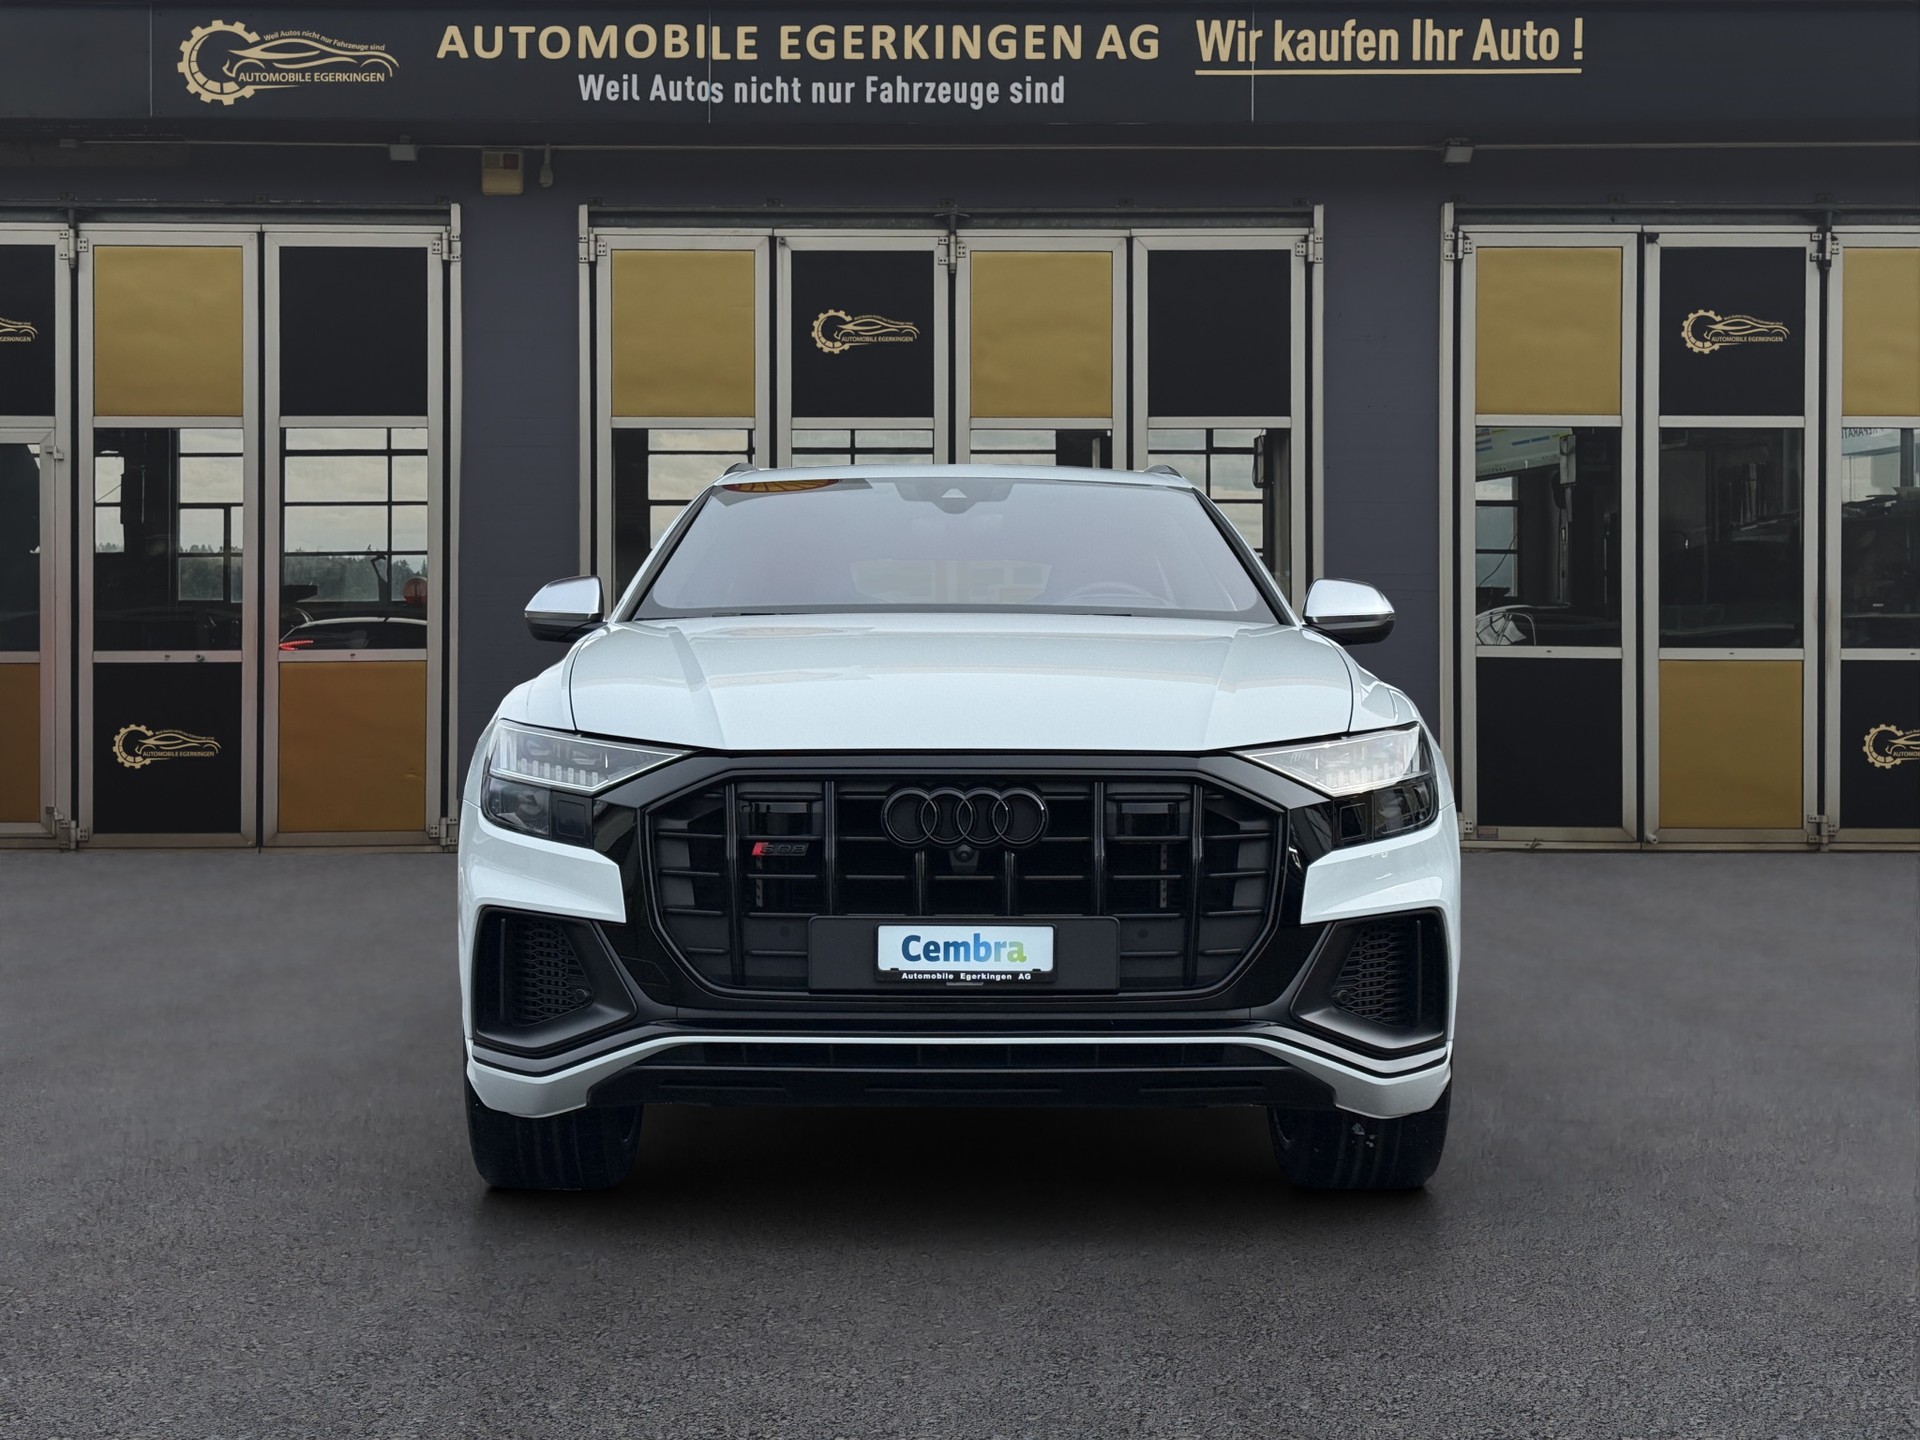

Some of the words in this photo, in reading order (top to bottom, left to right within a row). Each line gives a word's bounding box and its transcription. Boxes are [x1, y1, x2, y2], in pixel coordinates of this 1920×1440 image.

[264, 32, 280, 41] Weil
[301, 31, 320, 40] nicht
[320, 35, 333, 44] nur
[333, 39, 369, 51] Fahrzeuge
[436, 24, 758, 60] AUTOMOBILE
[779, 24, 1082, 60] EGERKINGEN
[1095, 24, 1160, 60] AG
[1195, 18, 1263, 63] Wir
[1273, 18, 1399, 62] kaufen
[1411, 18, 1464, 62] Ihr
[1472, 17, 1560, 62] Auto
[1573, 17, 1584, 61] !
[238, 72, 312, 82] AUTOMOBILE
[314, 72, 385, 82] EGERKINGEN
[578, 73, 639, 101] Weil
[649, 74, 724, 103] Autos
[734, 75, 801, 104] nicht
[811, 80, 856, 104] nur
[865, 75, 1000, 110] Fahrzeuge
[1009, 75, 1065, 104] sind
[901, 933, 1028, 963] Cembra
[901, 972, 954, 980] Automobile
[960, 972, 1013, 982] Egerkingen
